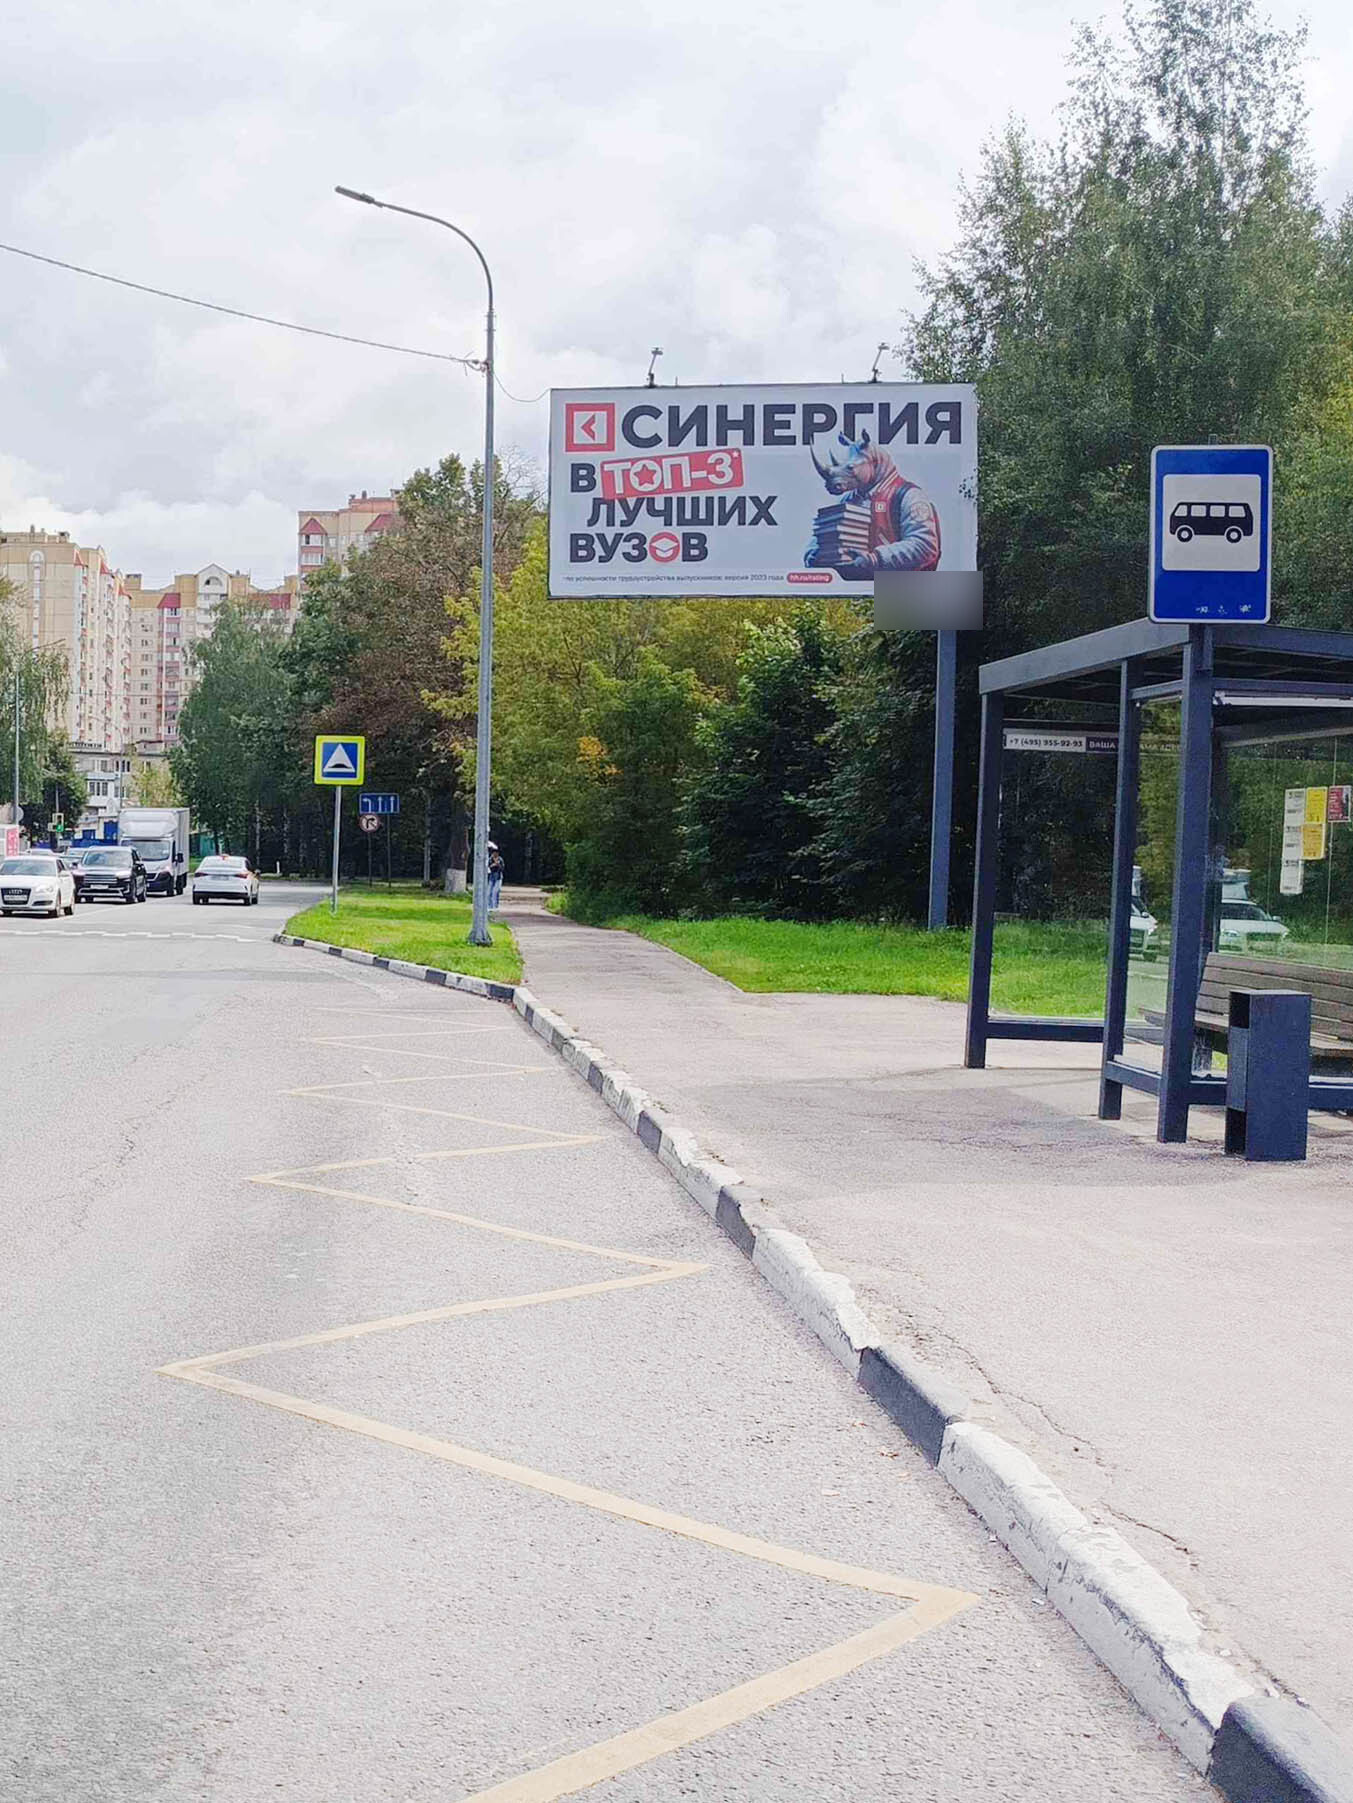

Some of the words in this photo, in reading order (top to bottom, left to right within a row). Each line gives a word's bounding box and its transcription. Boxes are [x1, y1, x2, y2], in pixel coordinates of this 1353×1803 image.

[621, 401, 962, 448] СИНЕРГИЯ
[570, 463, 597, 493] В
[586, 495, 778, 528] ЛУЧШИХ
[569, 532, 709, 563] ВУЗОВ
